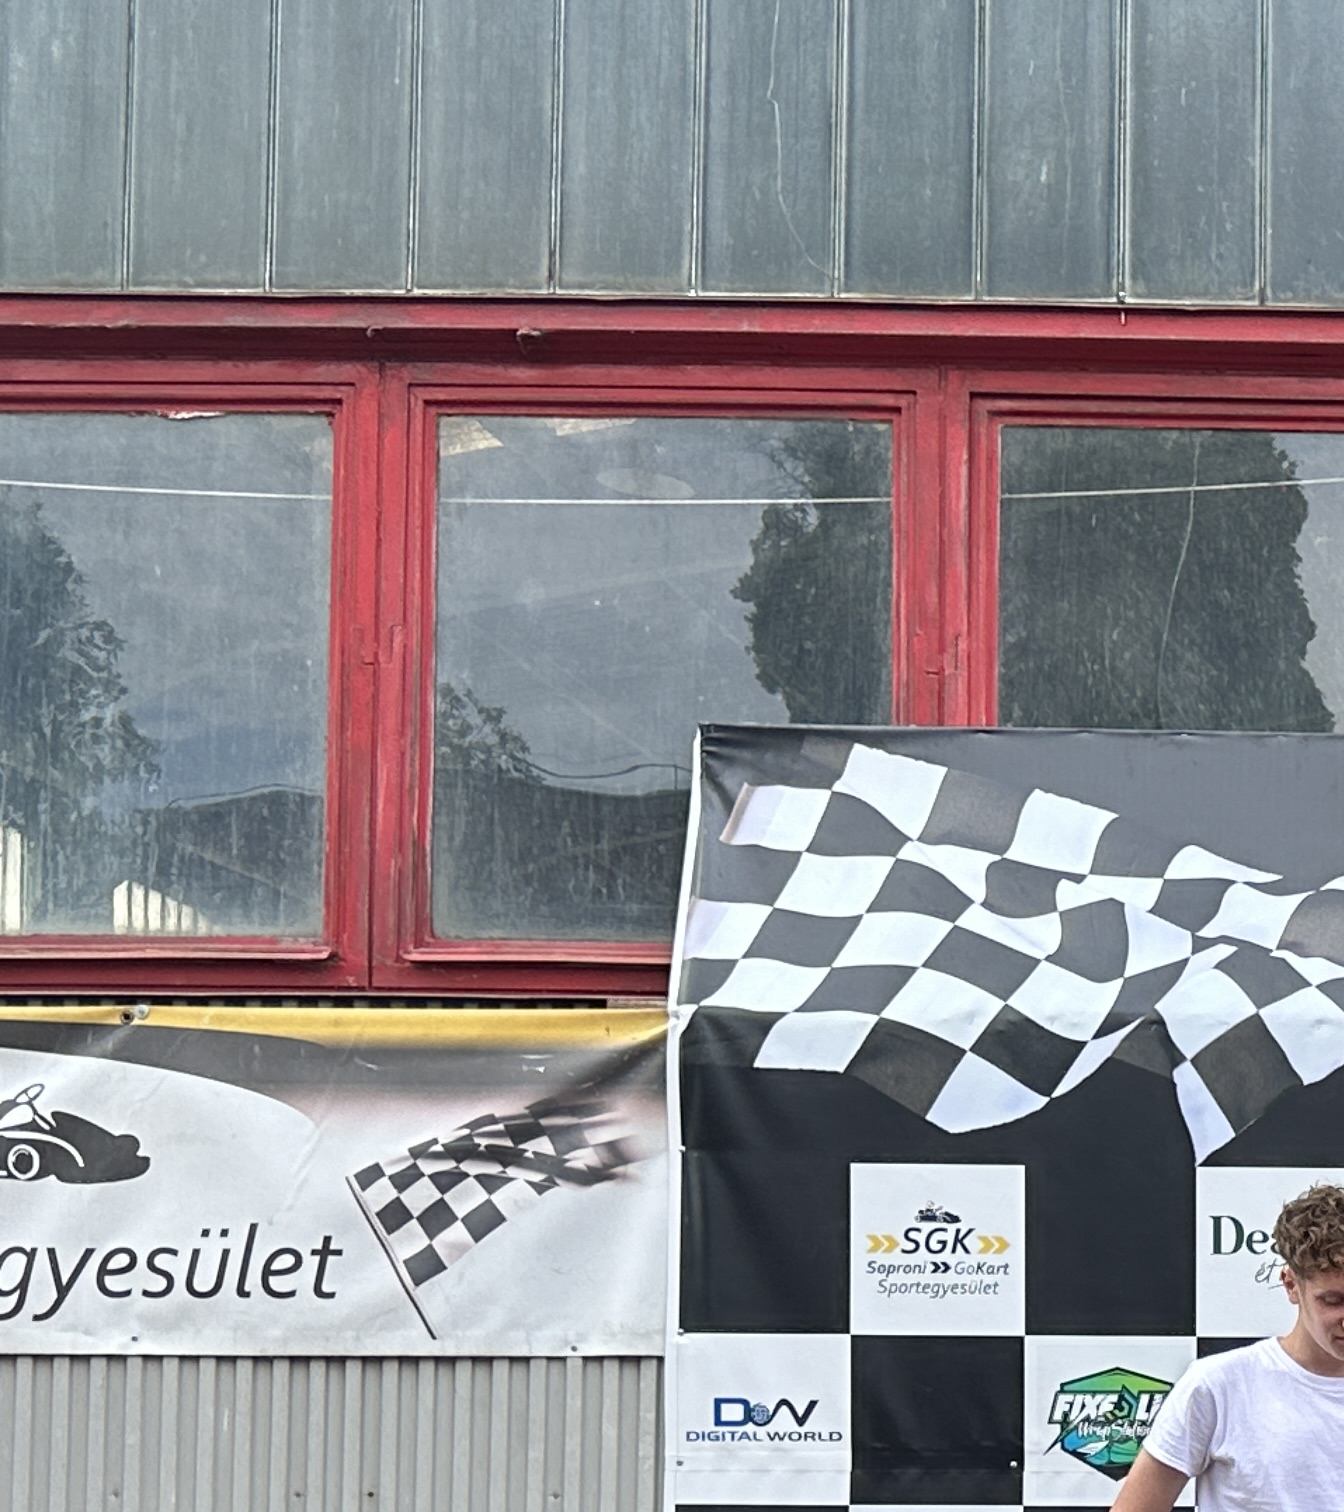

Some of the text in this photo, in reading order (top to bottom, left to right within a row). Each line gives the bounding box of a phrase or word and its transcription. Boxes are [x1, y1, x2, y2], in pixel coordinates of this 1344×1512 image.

[900, 1226, 975, 1255] SGK
[1209, 1215, 1282, 1255] De
[866, 1260, 1010, 1279] Soproni GoKart
[876, 1279, 999, 1299] Sportegyesület
[685, 1429, 842, 1443] DIGITAL WORLD
